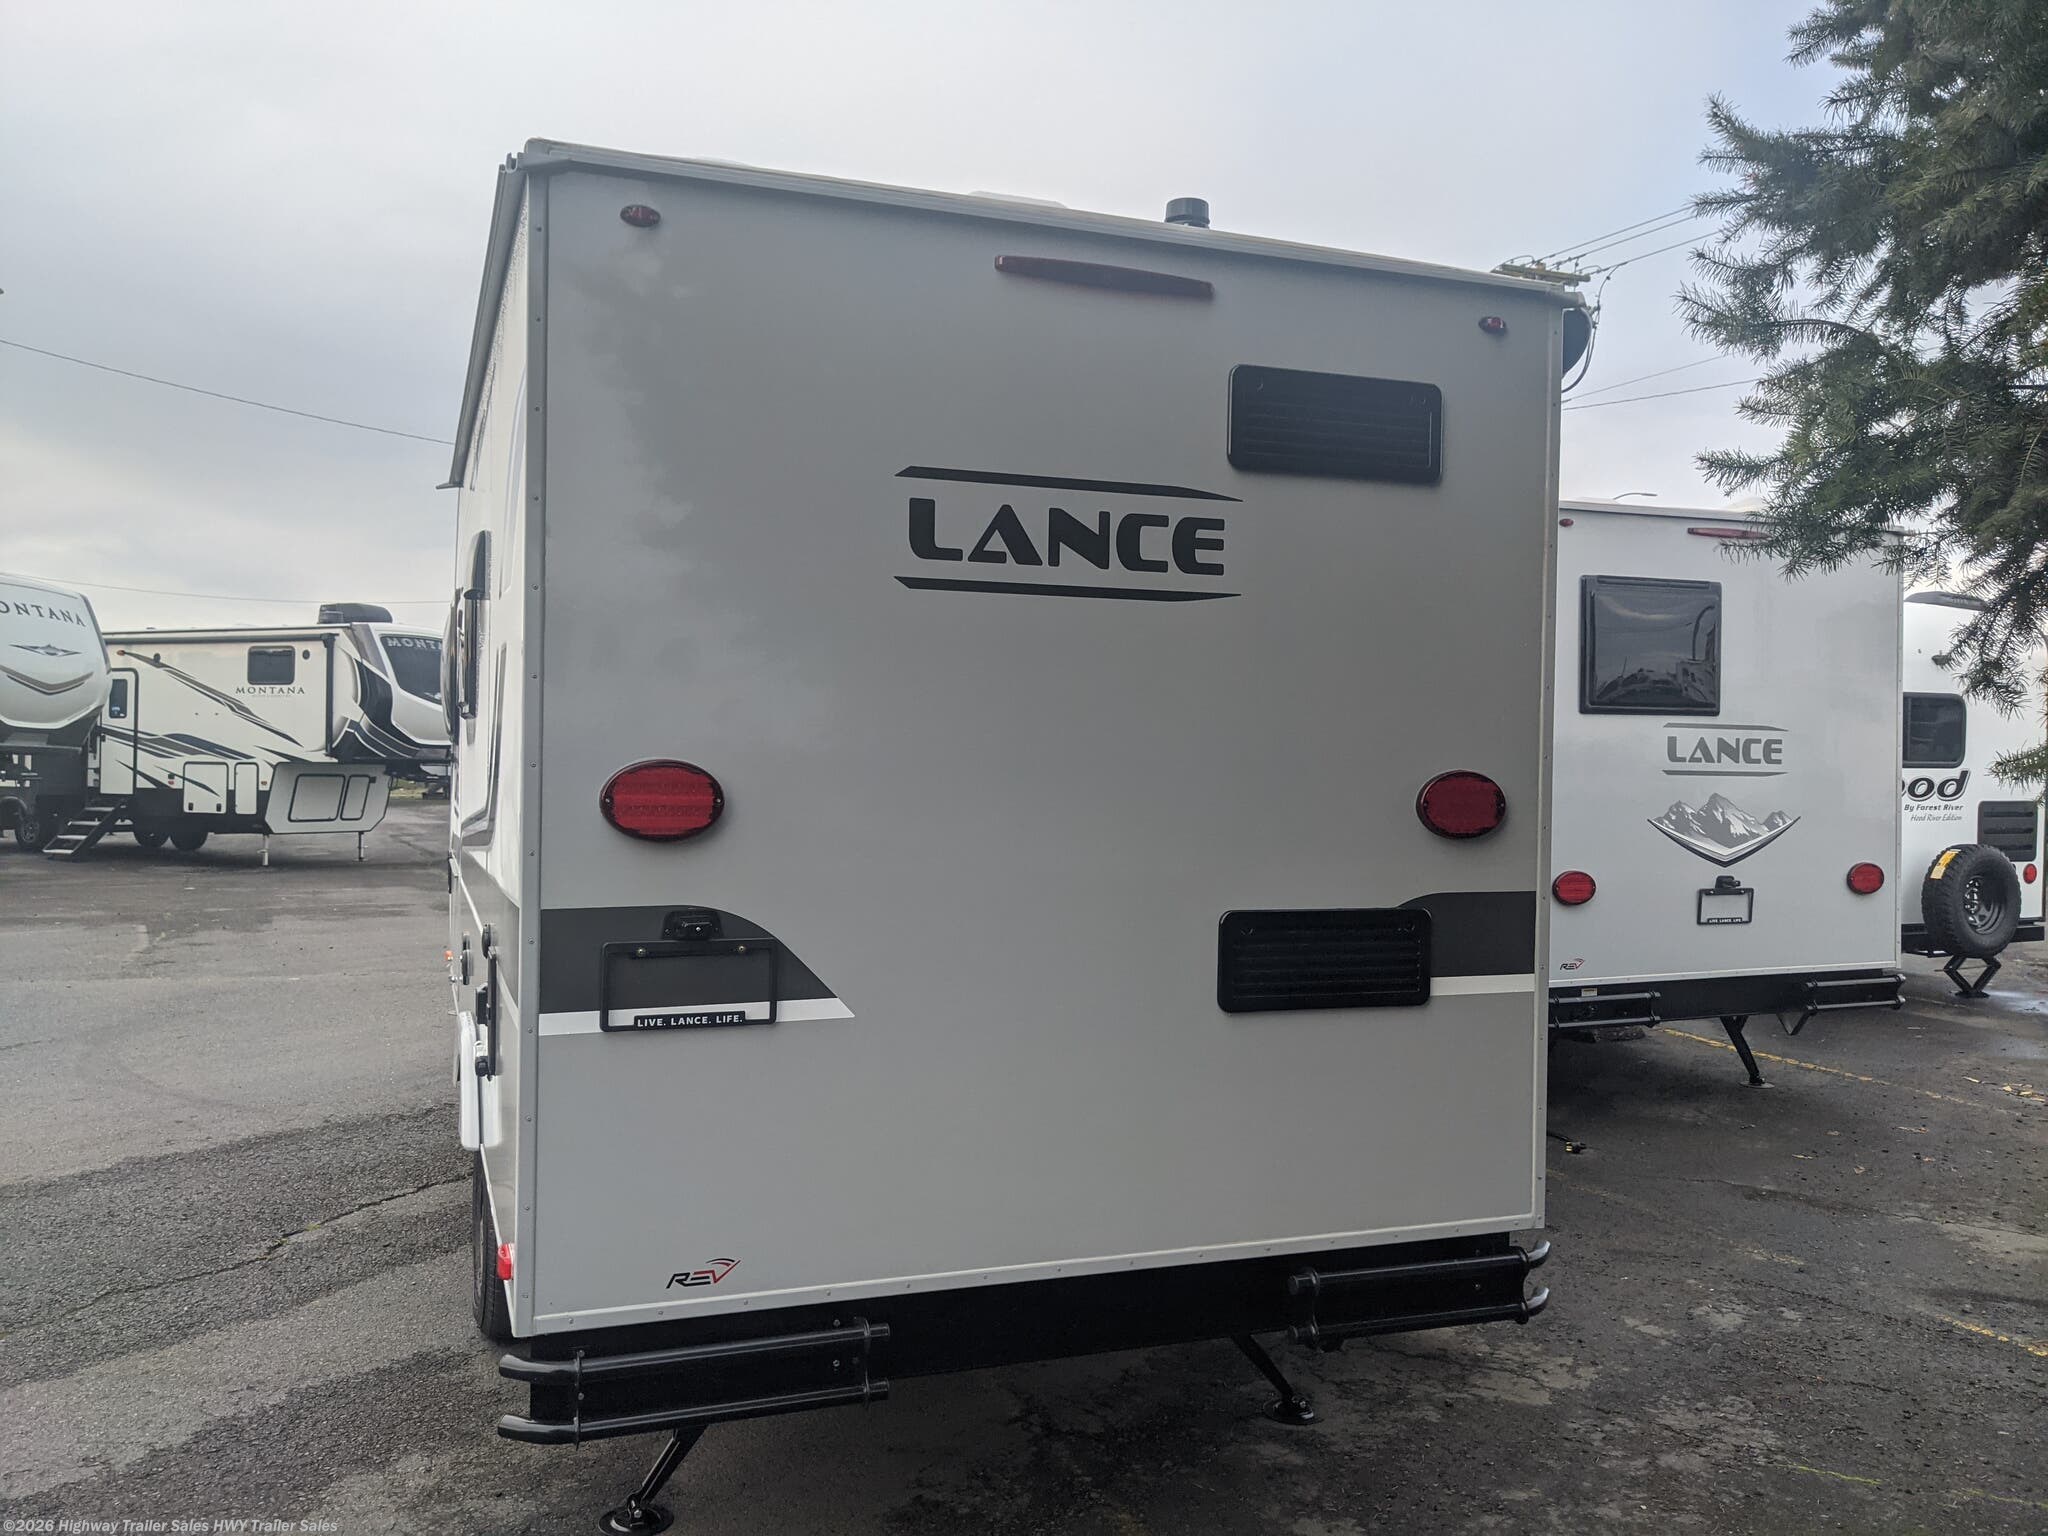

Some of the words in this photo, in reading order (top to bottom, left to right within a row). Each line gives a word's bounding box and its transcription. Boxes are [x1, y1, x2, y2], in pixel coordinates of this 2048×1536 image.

[909, 497, 1225, 576] LANCE
[235, 686, 305, 694] MONTANA
[1667, 736, 1783, 765] LANCE
[1902, 769, 1970, 801] od
[1904, 804, 1914, 812] By
[1560, 958, 1585, 970] REV
[637, 1018, 666, 1027] LIVE.
[670, 1016, 712, 1026] LANCE.
[716, 1014, 743, 1024] LIFE.
[666, 1258, 741, 1289] REV
